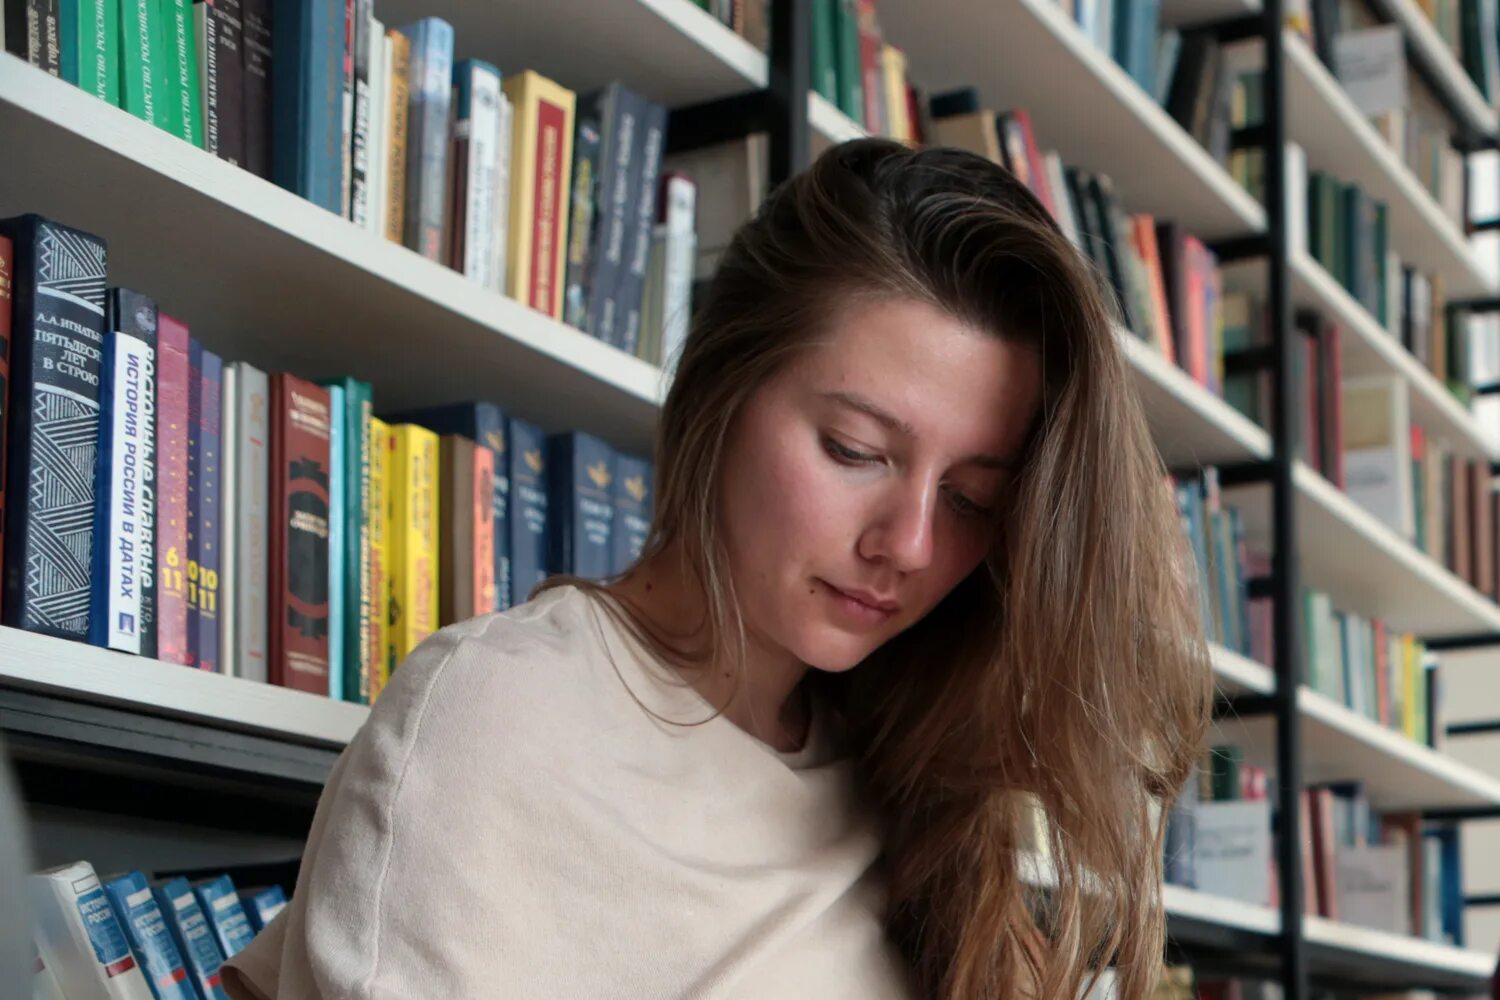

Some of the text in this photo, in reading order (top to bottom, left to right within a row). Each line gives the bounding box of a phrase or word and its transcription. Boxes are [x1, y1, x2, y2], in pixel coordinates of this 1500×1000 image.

[34, 329, 104, 363] ПЯТЬДЕСЯ
[61, 350, 87, 368] ЛЕТ
[43, 357, 100, 386] В СТРОЮ
[119, 353, 139, 600] ИСТОРИЯ РОССИИ В ДАТАХ
[165, 546, 179, 568] 6
[163, 567, 182, 591] 11
[199, 566, 218, 591] 10
[199, 588, 216, 612] 11
